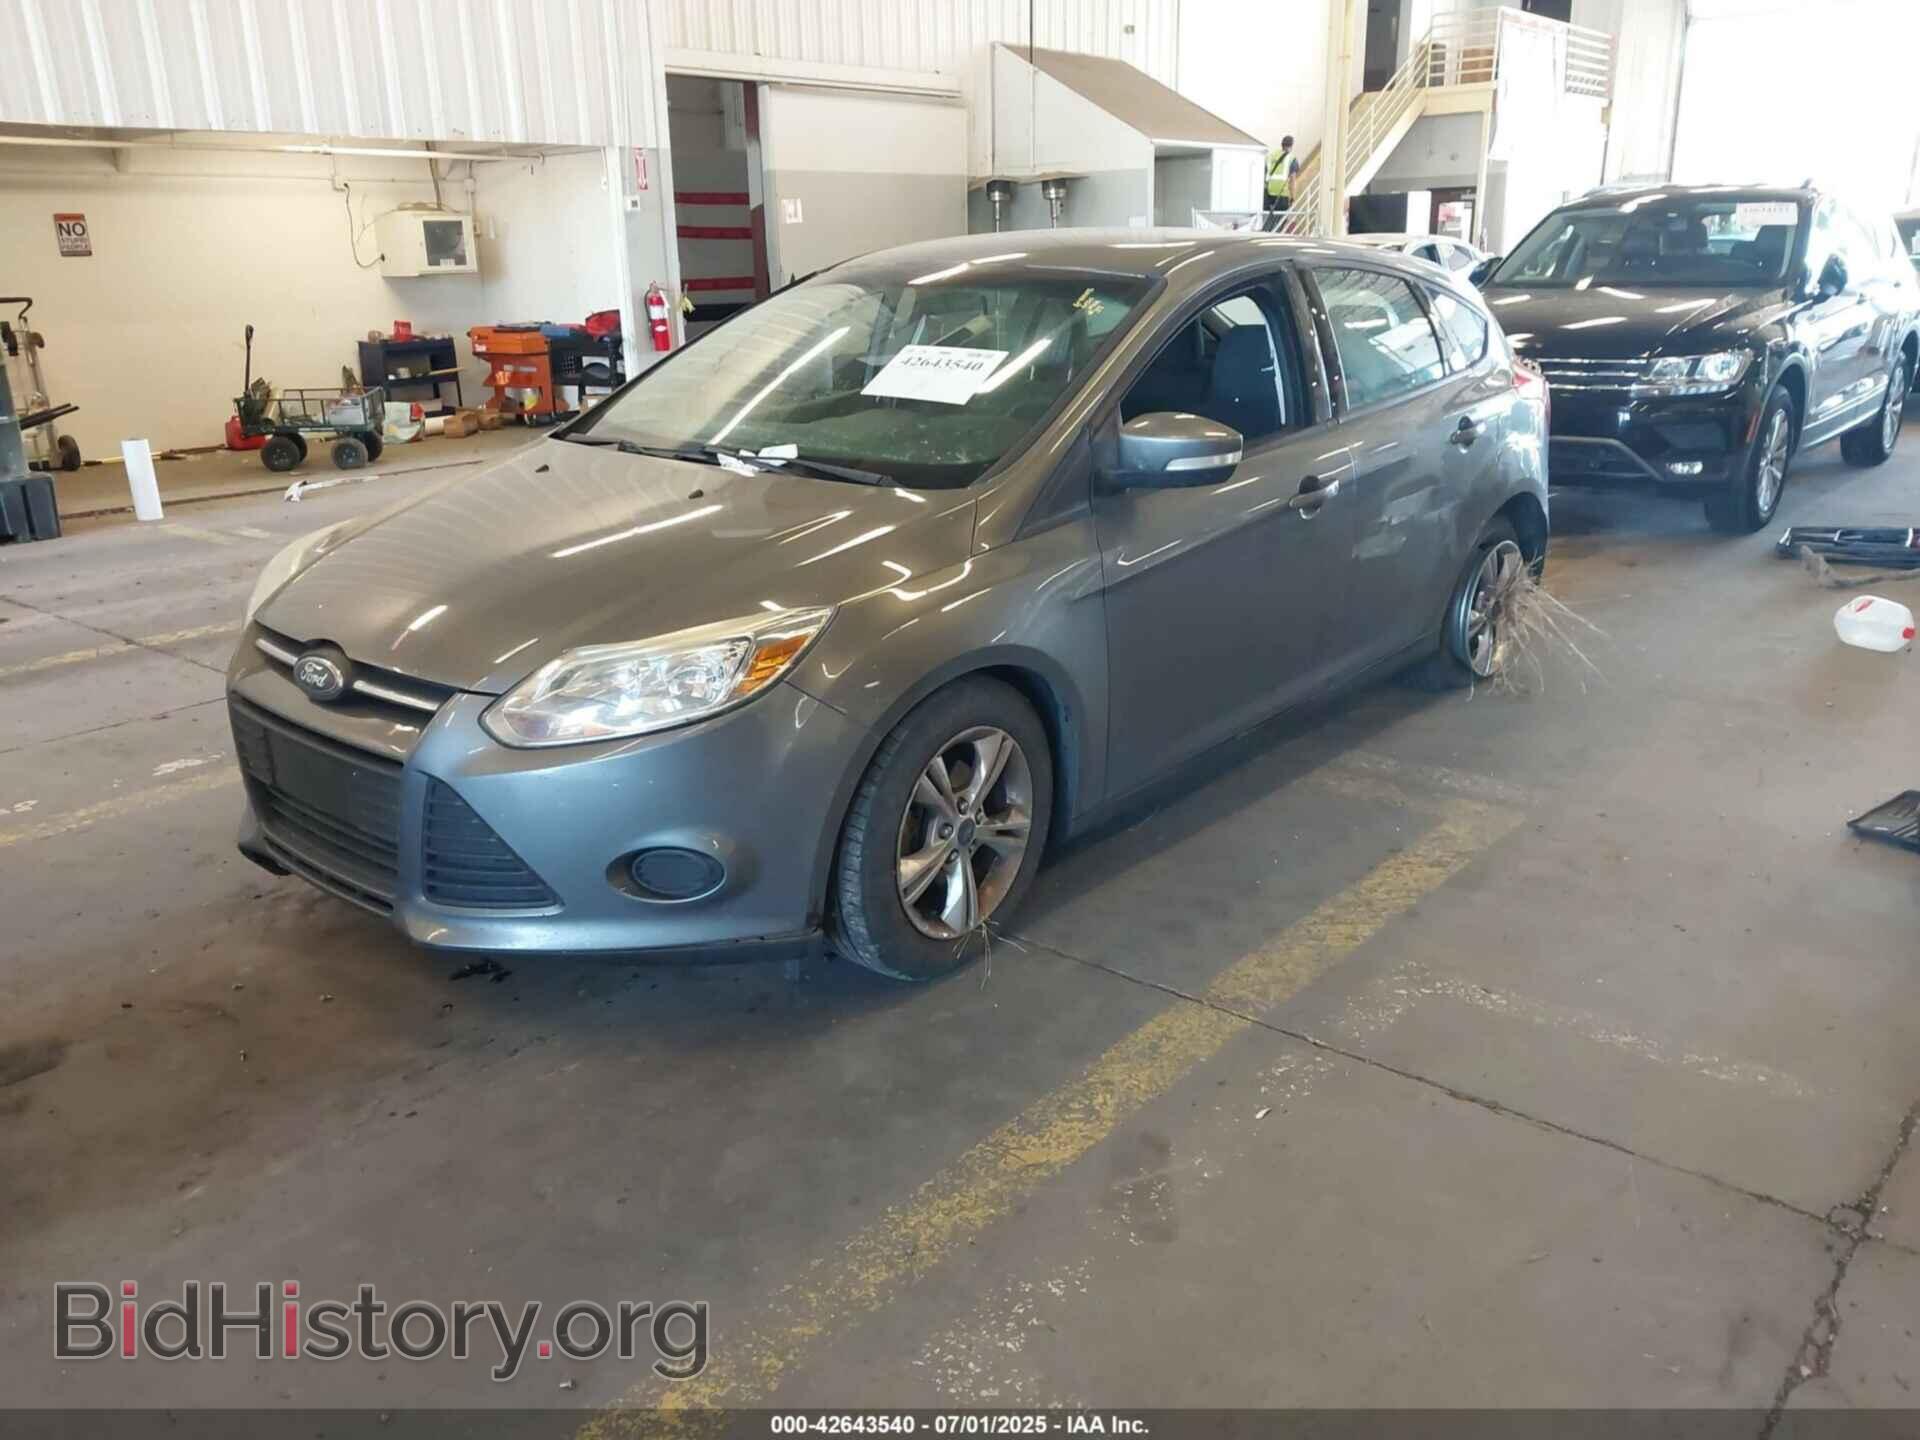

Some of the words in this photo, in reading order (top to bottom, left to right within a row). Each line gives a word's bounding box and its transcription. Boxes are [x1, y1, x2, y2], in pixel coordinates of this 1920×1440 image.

[58, 222, 85, 237] NO
[900, 356, 985, 371] 42643540
[300, 662, 329, 687] Ford
